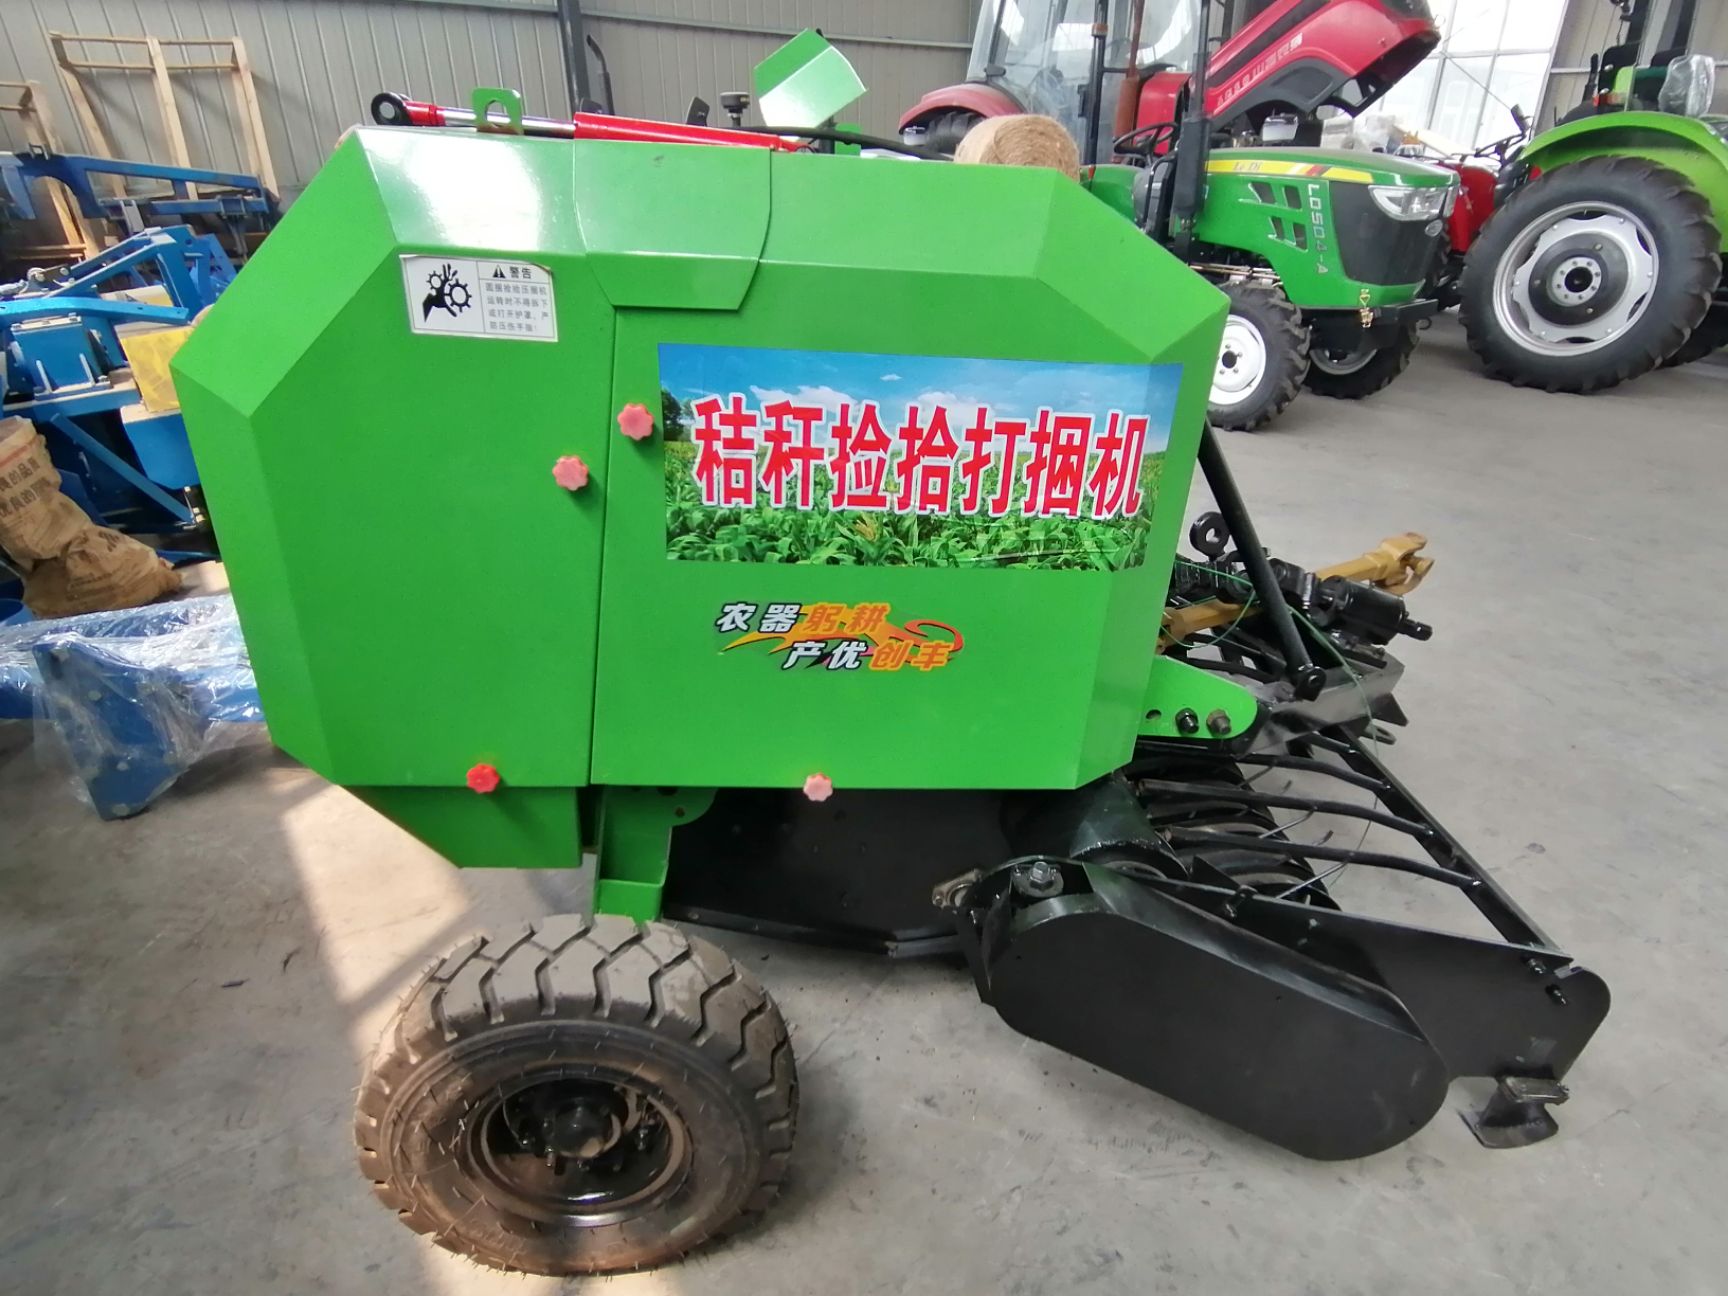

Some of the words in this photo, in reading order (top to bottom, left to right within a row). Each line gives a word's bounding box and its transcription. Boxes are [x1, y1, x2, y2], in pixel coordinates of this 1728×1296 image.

[509, 266, 532, 279] 警告
[693, 394, 1151, 519] 秸秆捡拾打捆机
[715, 602, 891, 635] 农器躬耕
[781, 639, 954, 672] 产优创丰
